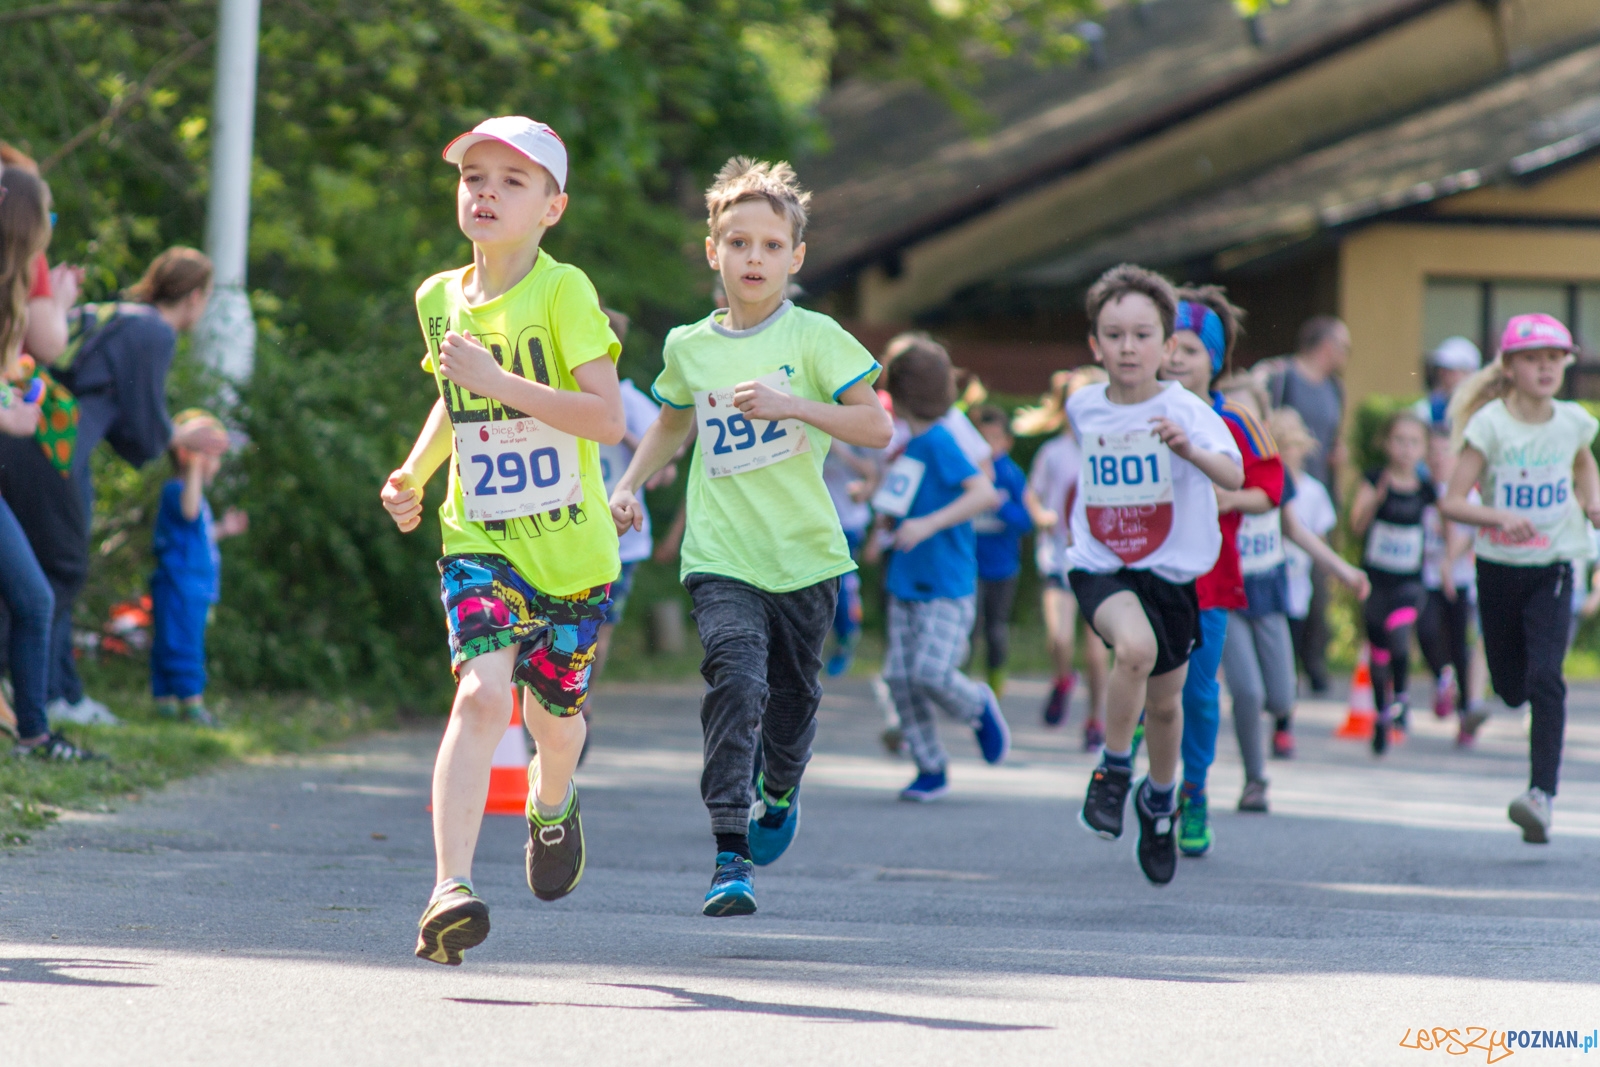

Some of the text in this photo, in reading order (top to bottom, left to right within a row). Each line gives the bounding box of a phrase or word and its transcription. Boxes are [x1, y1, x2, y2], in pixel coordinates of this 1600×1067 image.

[428, 316, 443, 337] BE
[491, 424, 516, 438] bieg
[525, 424, 539, 433] tak
[706, 413, 787, 455] 292
[471, 446, 561, 496] 290
[1088, 453, 1160, 486] 1801
[1502, 477, 1568, 509] 1806
